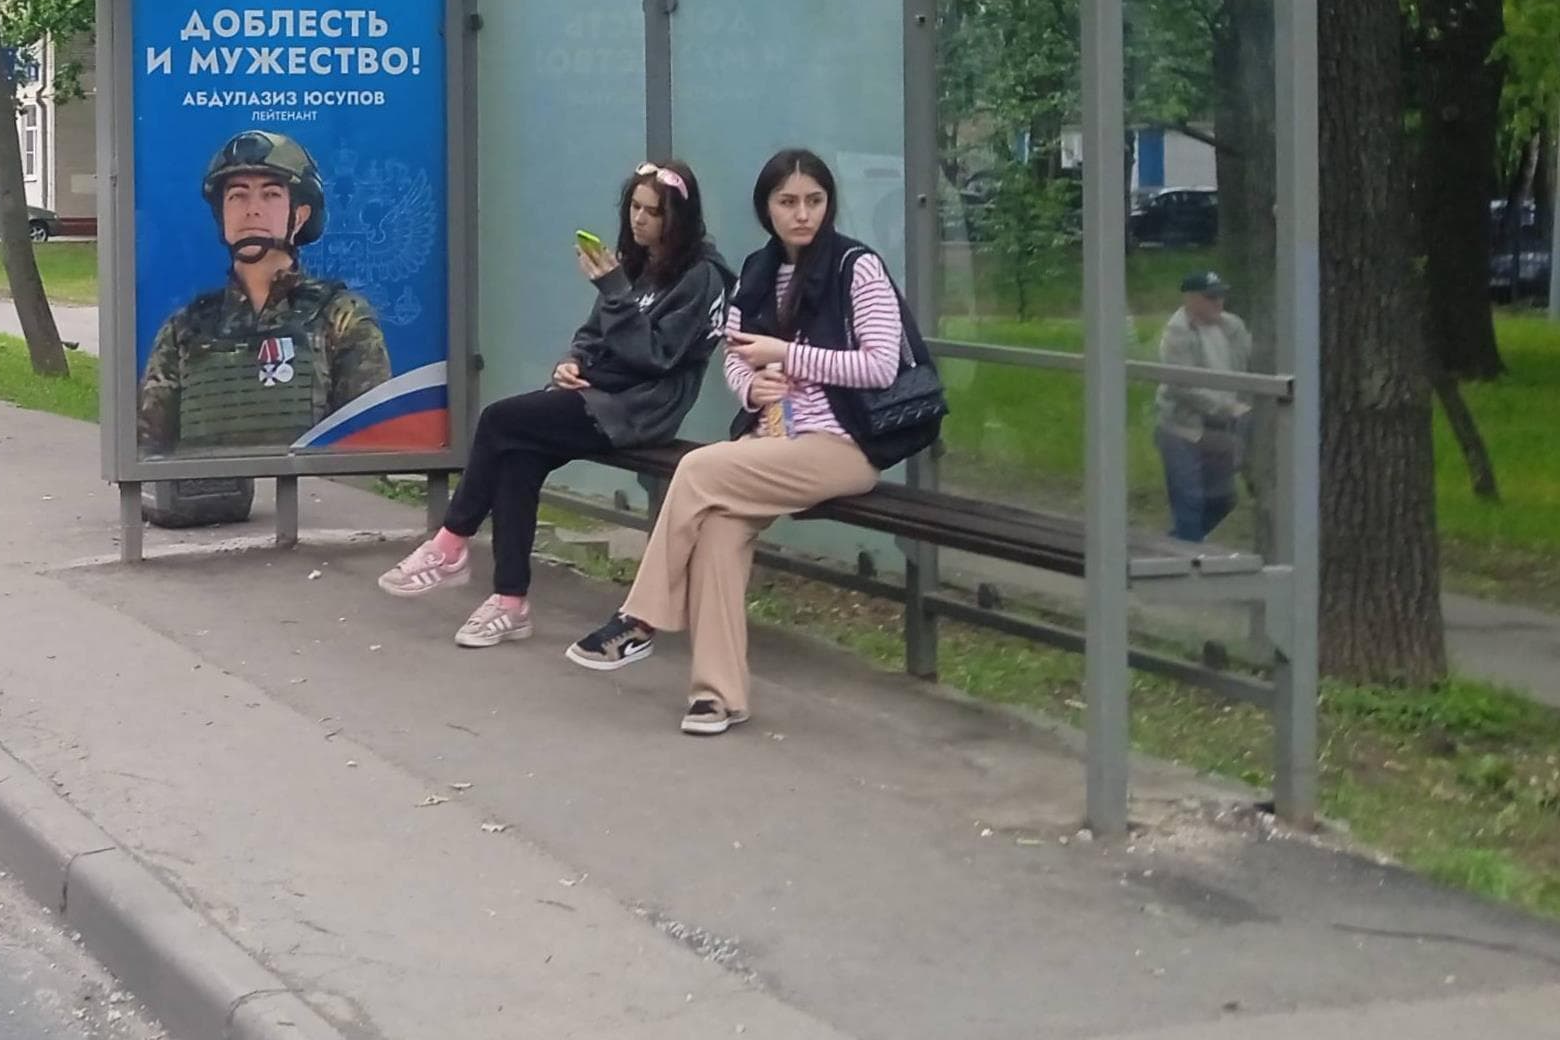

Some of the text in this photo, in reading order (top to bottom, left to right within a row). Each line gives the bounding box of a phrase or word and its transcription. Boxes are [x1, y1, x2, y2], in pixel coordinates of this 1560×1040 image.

[180, 9, 389, 41] ДОБЛЕСТЬ
[146, 47, 421, 75] И МУЖЕСТВО!
[183, 91, 386, 108] АБДУЛАЗИЗ ЮСУПОВ
[251, 109, 318, 122] ЛЕЙТЕНАНТ
